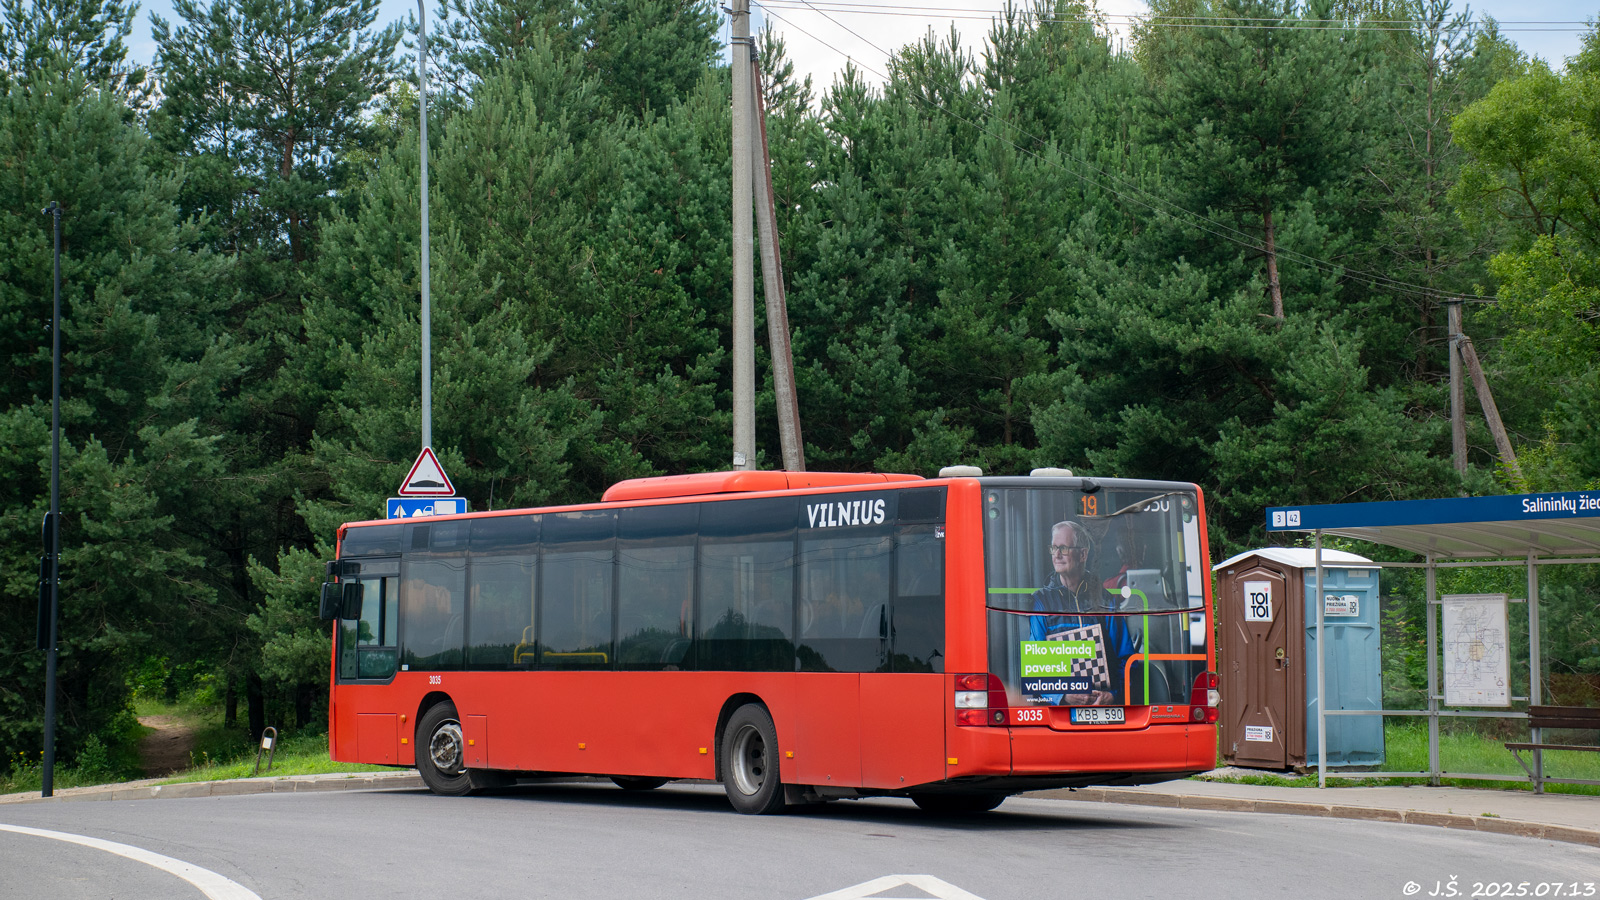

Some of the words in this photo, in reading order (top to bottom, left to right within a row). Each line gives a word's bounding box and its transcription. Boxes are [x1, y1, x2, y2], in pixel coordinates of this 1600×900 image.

[1081, 495, 1098, 516] 19
[1522, 496, 1577, 514] Salininkų
[807, 498, 886, 529] VILNIUS
[1277, 514, 1281, 523] 3
[1289, 514, 1297, 523] 42
[1250, 592, 1269, 605] TOI
[1251, 605, 1269, 618] TOI
[1025, 643, 1048, 655] Piko
[1050, 643, 1092, 657] valandą
[1025, 661, 1068, 676] paversk
[429, 675, 441, 685] 3035
[1025, 679, 1068, 691] valanda
[1070, 682, 1089, 690] sau
[1017, 710, 1043, 722] 3035
[1077, 709, 1099, 721] KBB
[1104, 709, 1123, 720] 590
